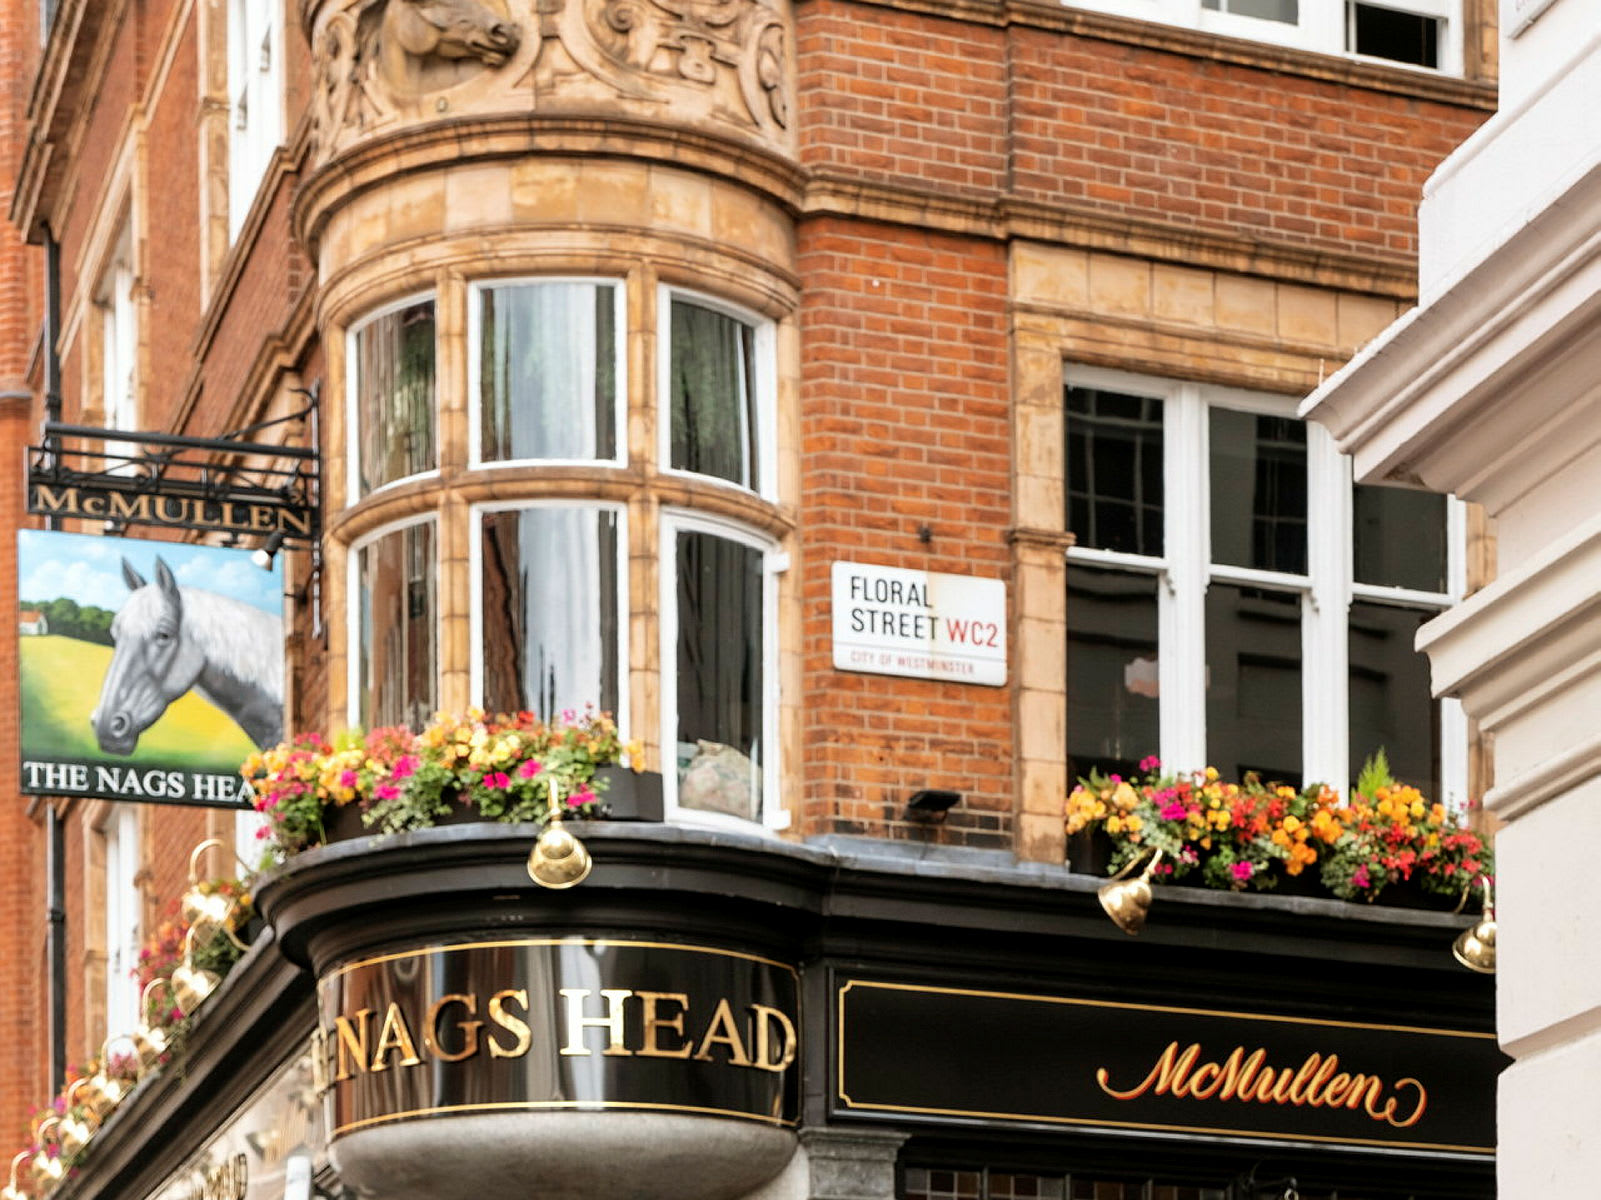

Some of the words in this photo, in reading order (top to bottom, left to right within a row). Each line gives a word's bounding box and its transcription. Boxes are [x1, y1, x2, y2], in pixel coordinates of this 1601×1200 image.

[34, 484, 311, 534] McMULLEN
[851, 576, 933, 608] FLORAL
[851, 608, 938, 640] STREET
[947, 619, 999, 648] WC2
[851, 651, 875, 664] CITY
[880, 654, 892, 665] OF
[898, 656, 975, 674] WESTMINSTER
[23, 761, 90, 791] THE
[96, 766, 186, 798] NAGS
[192, 773, 257, 803] HEA
[334, 988, 531, 1081] NAGS
[559, 988, 797, 1073] HEAD
[1097, 1041, 1426, 1127] McMullen
